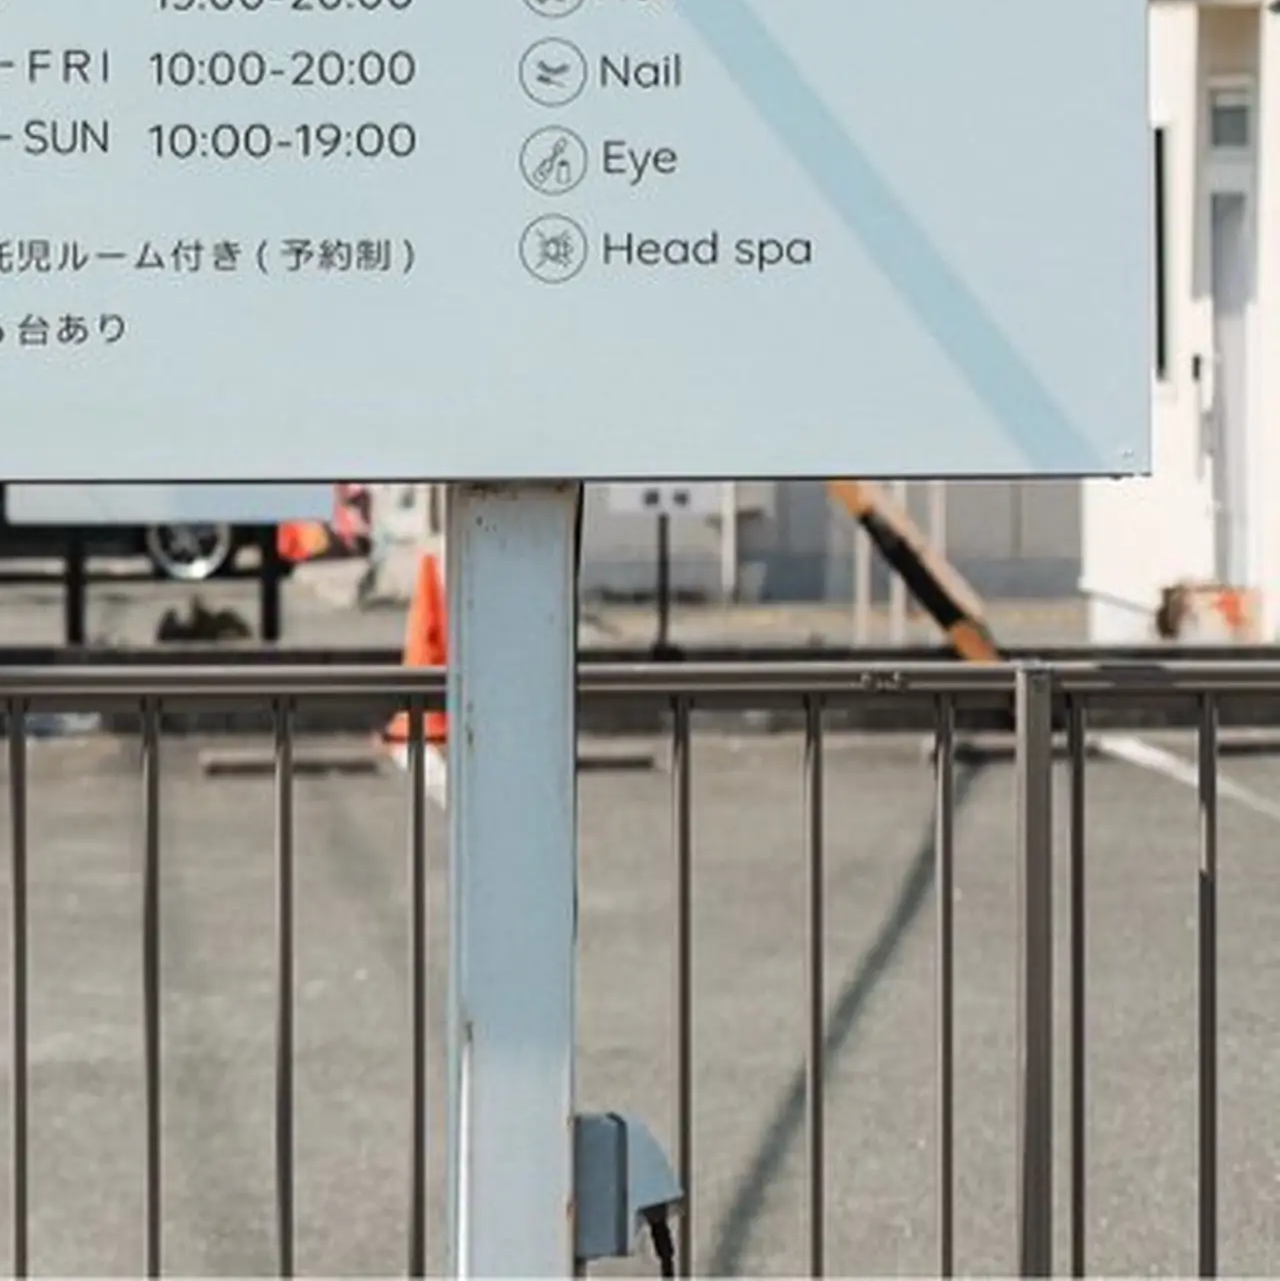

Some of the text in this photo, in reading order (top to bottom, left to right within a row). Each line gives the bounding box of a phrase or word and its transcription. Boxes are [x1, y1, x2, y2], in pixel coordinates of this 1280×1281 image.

[149, 49, 416, 88] 10:00-20:00
[599, 52, 682, 89] Nail
[148, 121, 417, 160] 10:00-19:00
[602, 139, 679, 185] Eye
[602, 229, 813, 275] Head spa
